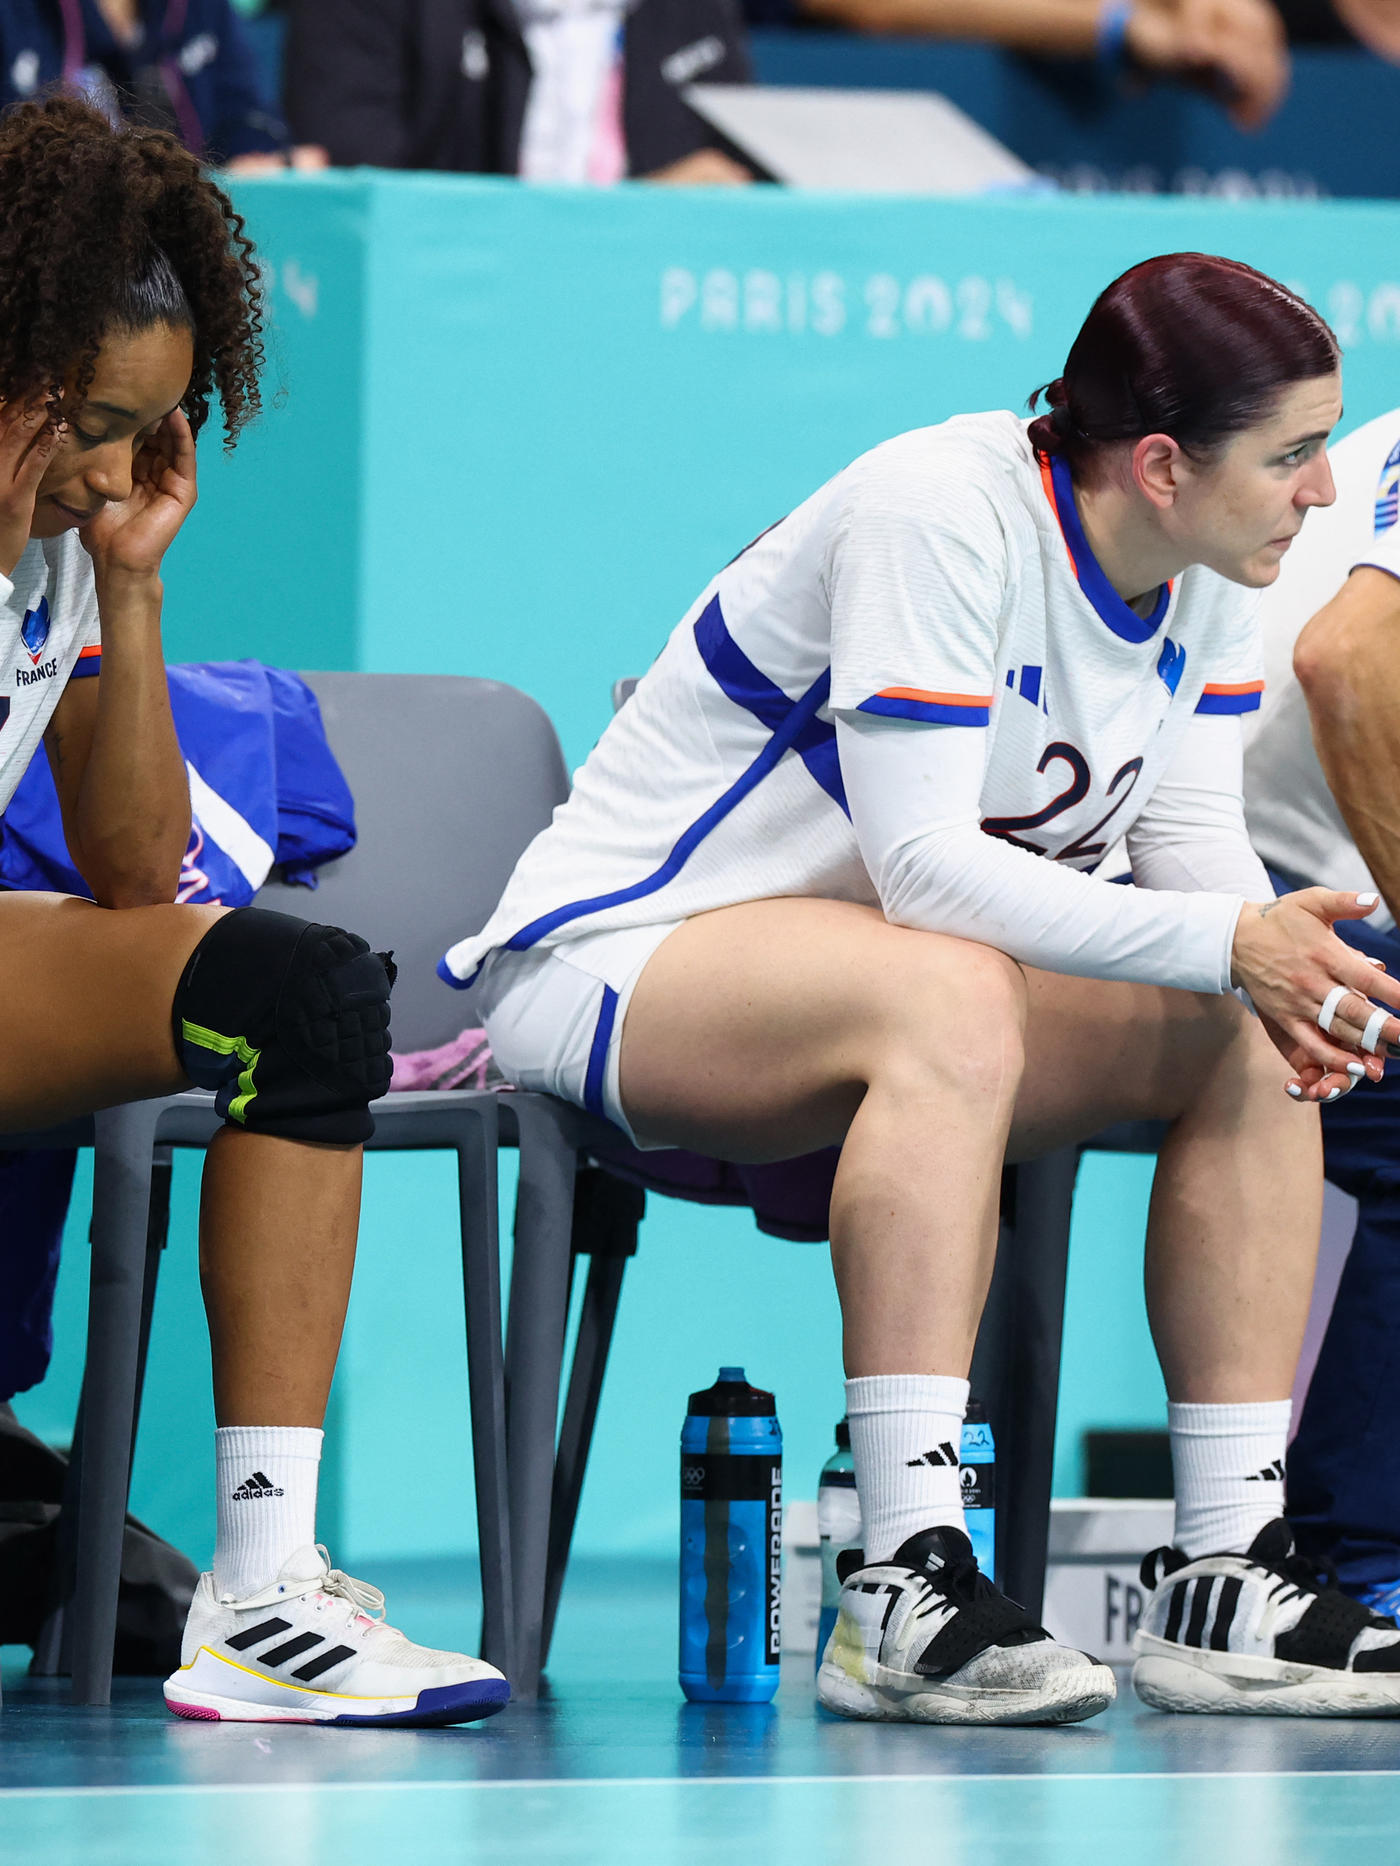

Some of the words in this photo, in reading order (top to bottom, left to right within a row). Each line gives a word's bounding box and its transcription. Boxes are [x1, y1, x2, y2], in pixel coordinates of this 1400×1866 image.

[660, 266, 846, 336] PARIS
[863, 272, 1034, 341] 2024
[16, 658, 57, 687] FRANCE
[980, 741, 1144, 860] 22
[964, 1430, 990, 1447] 22
[232, 1488, 285, 1501] adidas
